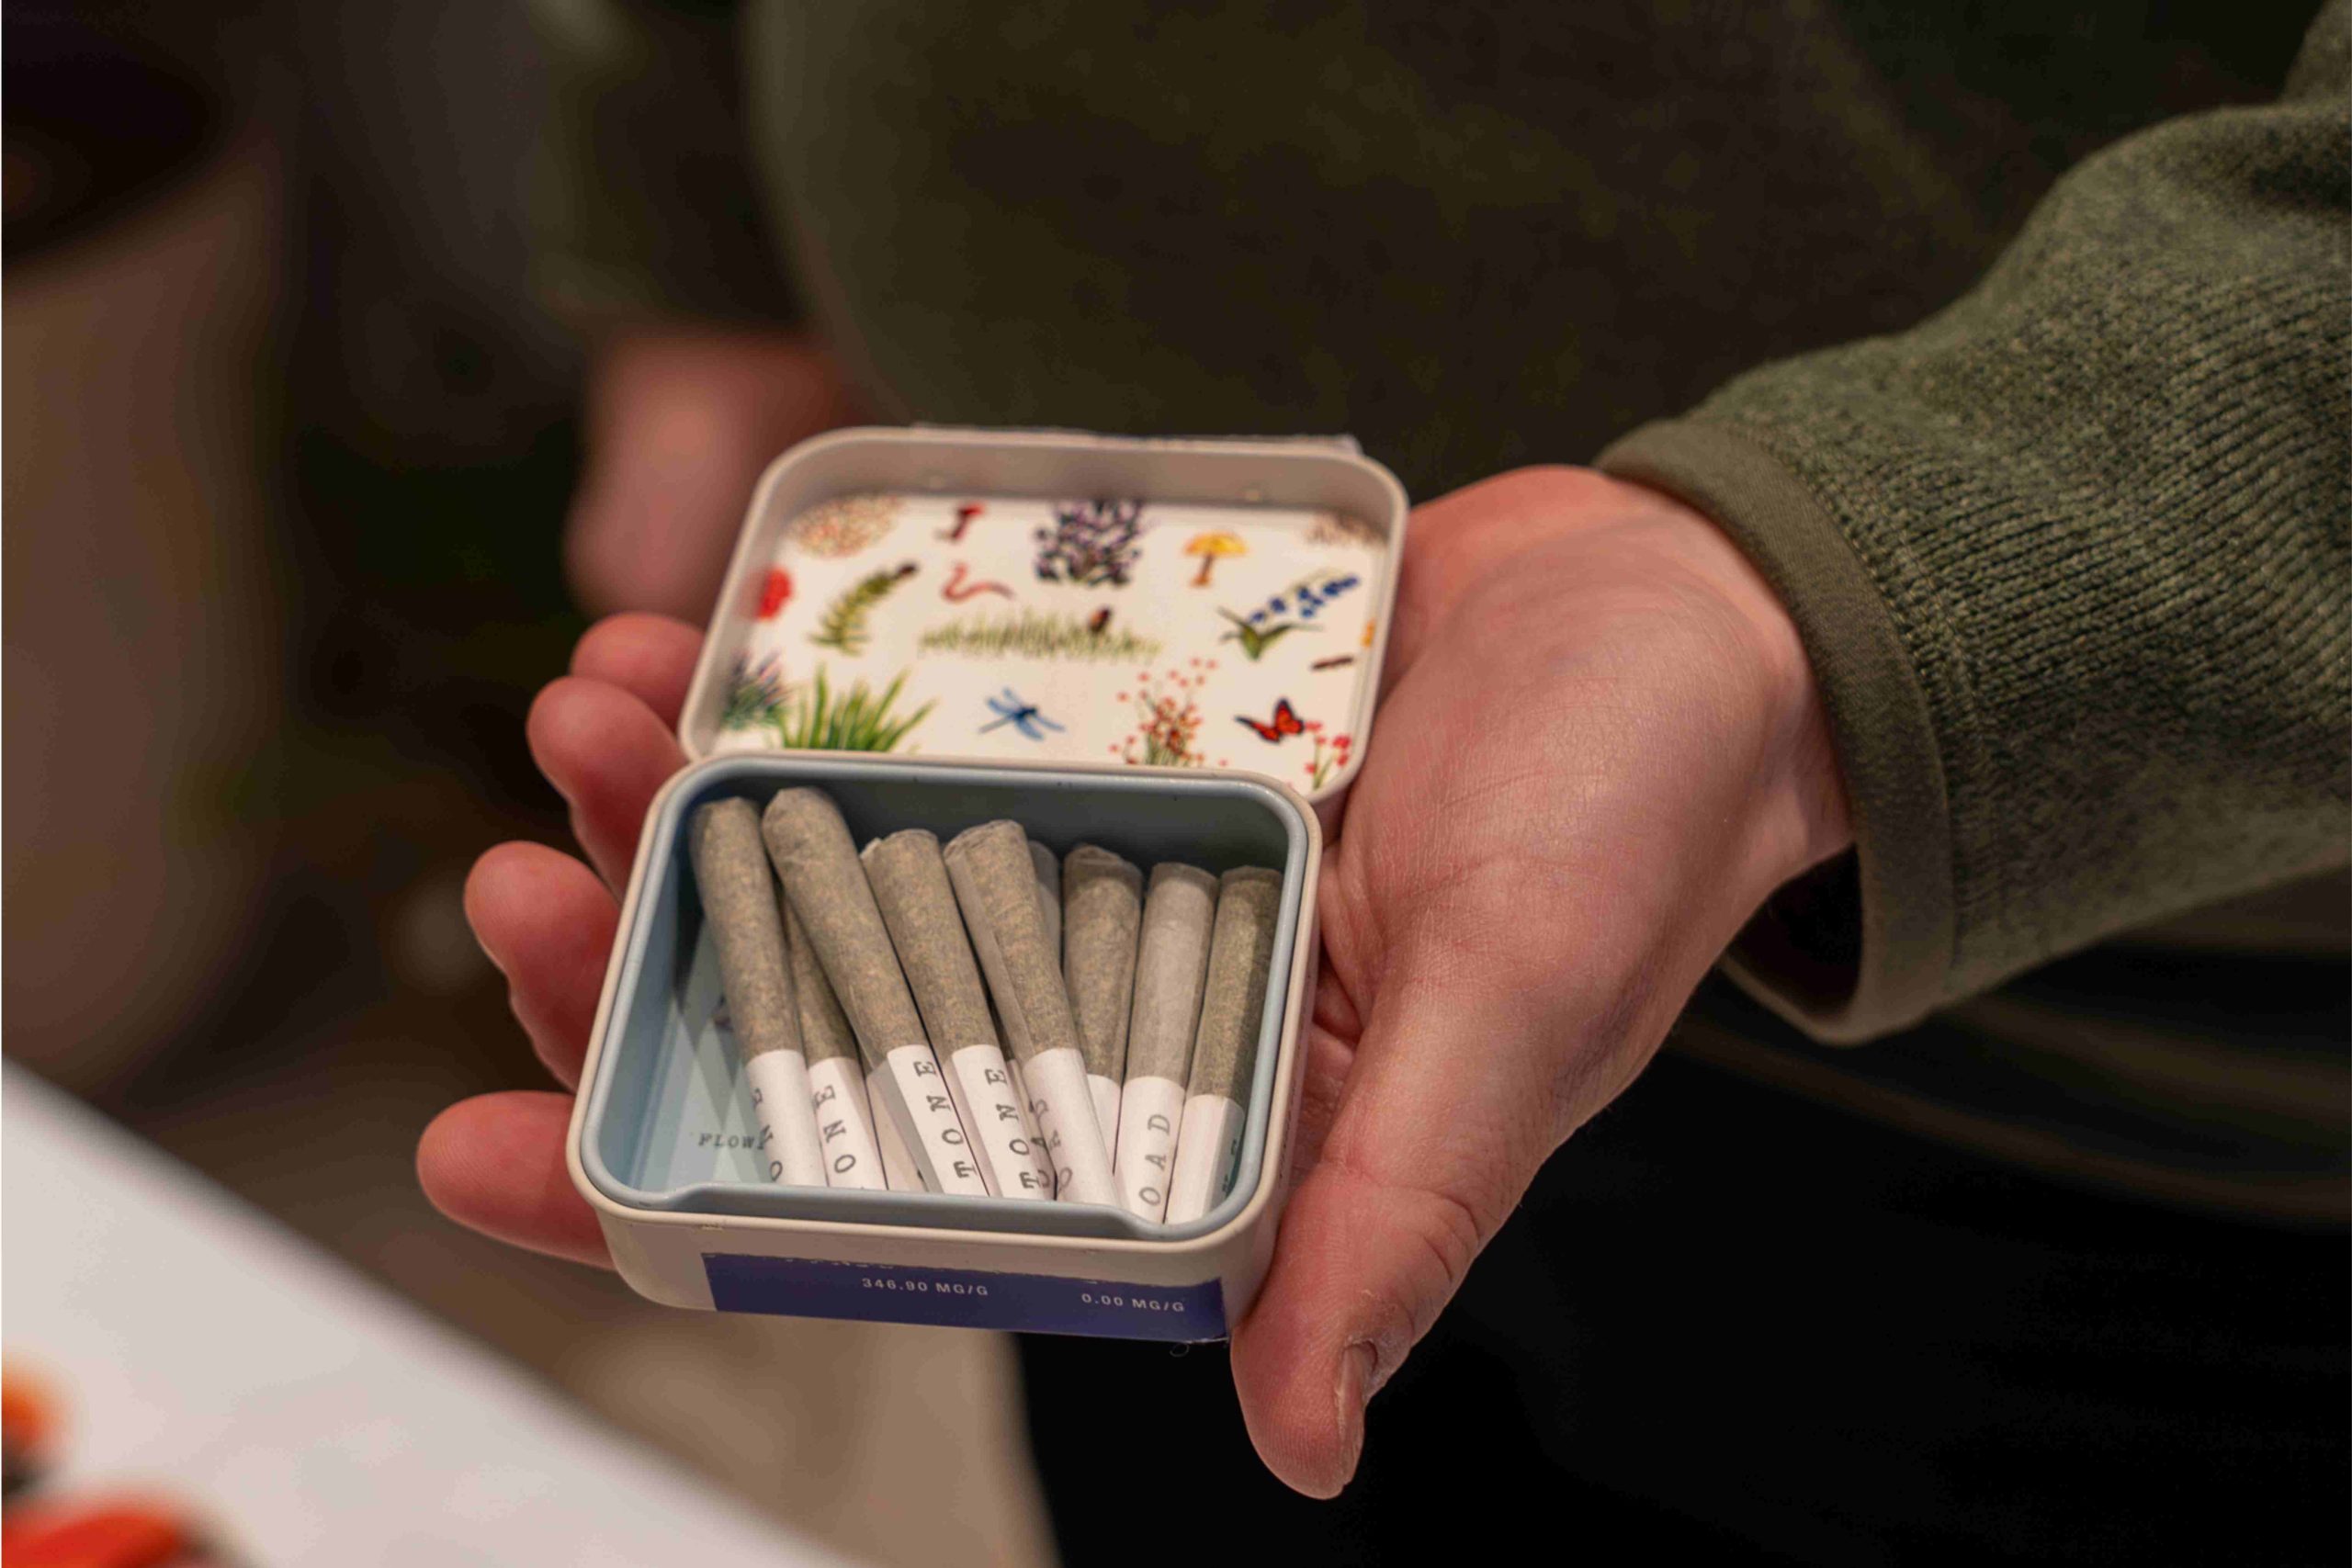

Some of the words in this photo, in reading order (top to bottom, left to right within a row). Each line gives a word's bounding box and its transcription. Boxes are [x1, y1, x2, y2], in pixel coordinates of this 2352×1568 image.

[862, 1278, 929, 1292] 346.90
[935, 1282, 989, 1296] MG/G
[1081, 1293, 1123, 1306] 0.00
[1131, 1298, 1184, 1312] MG/G
